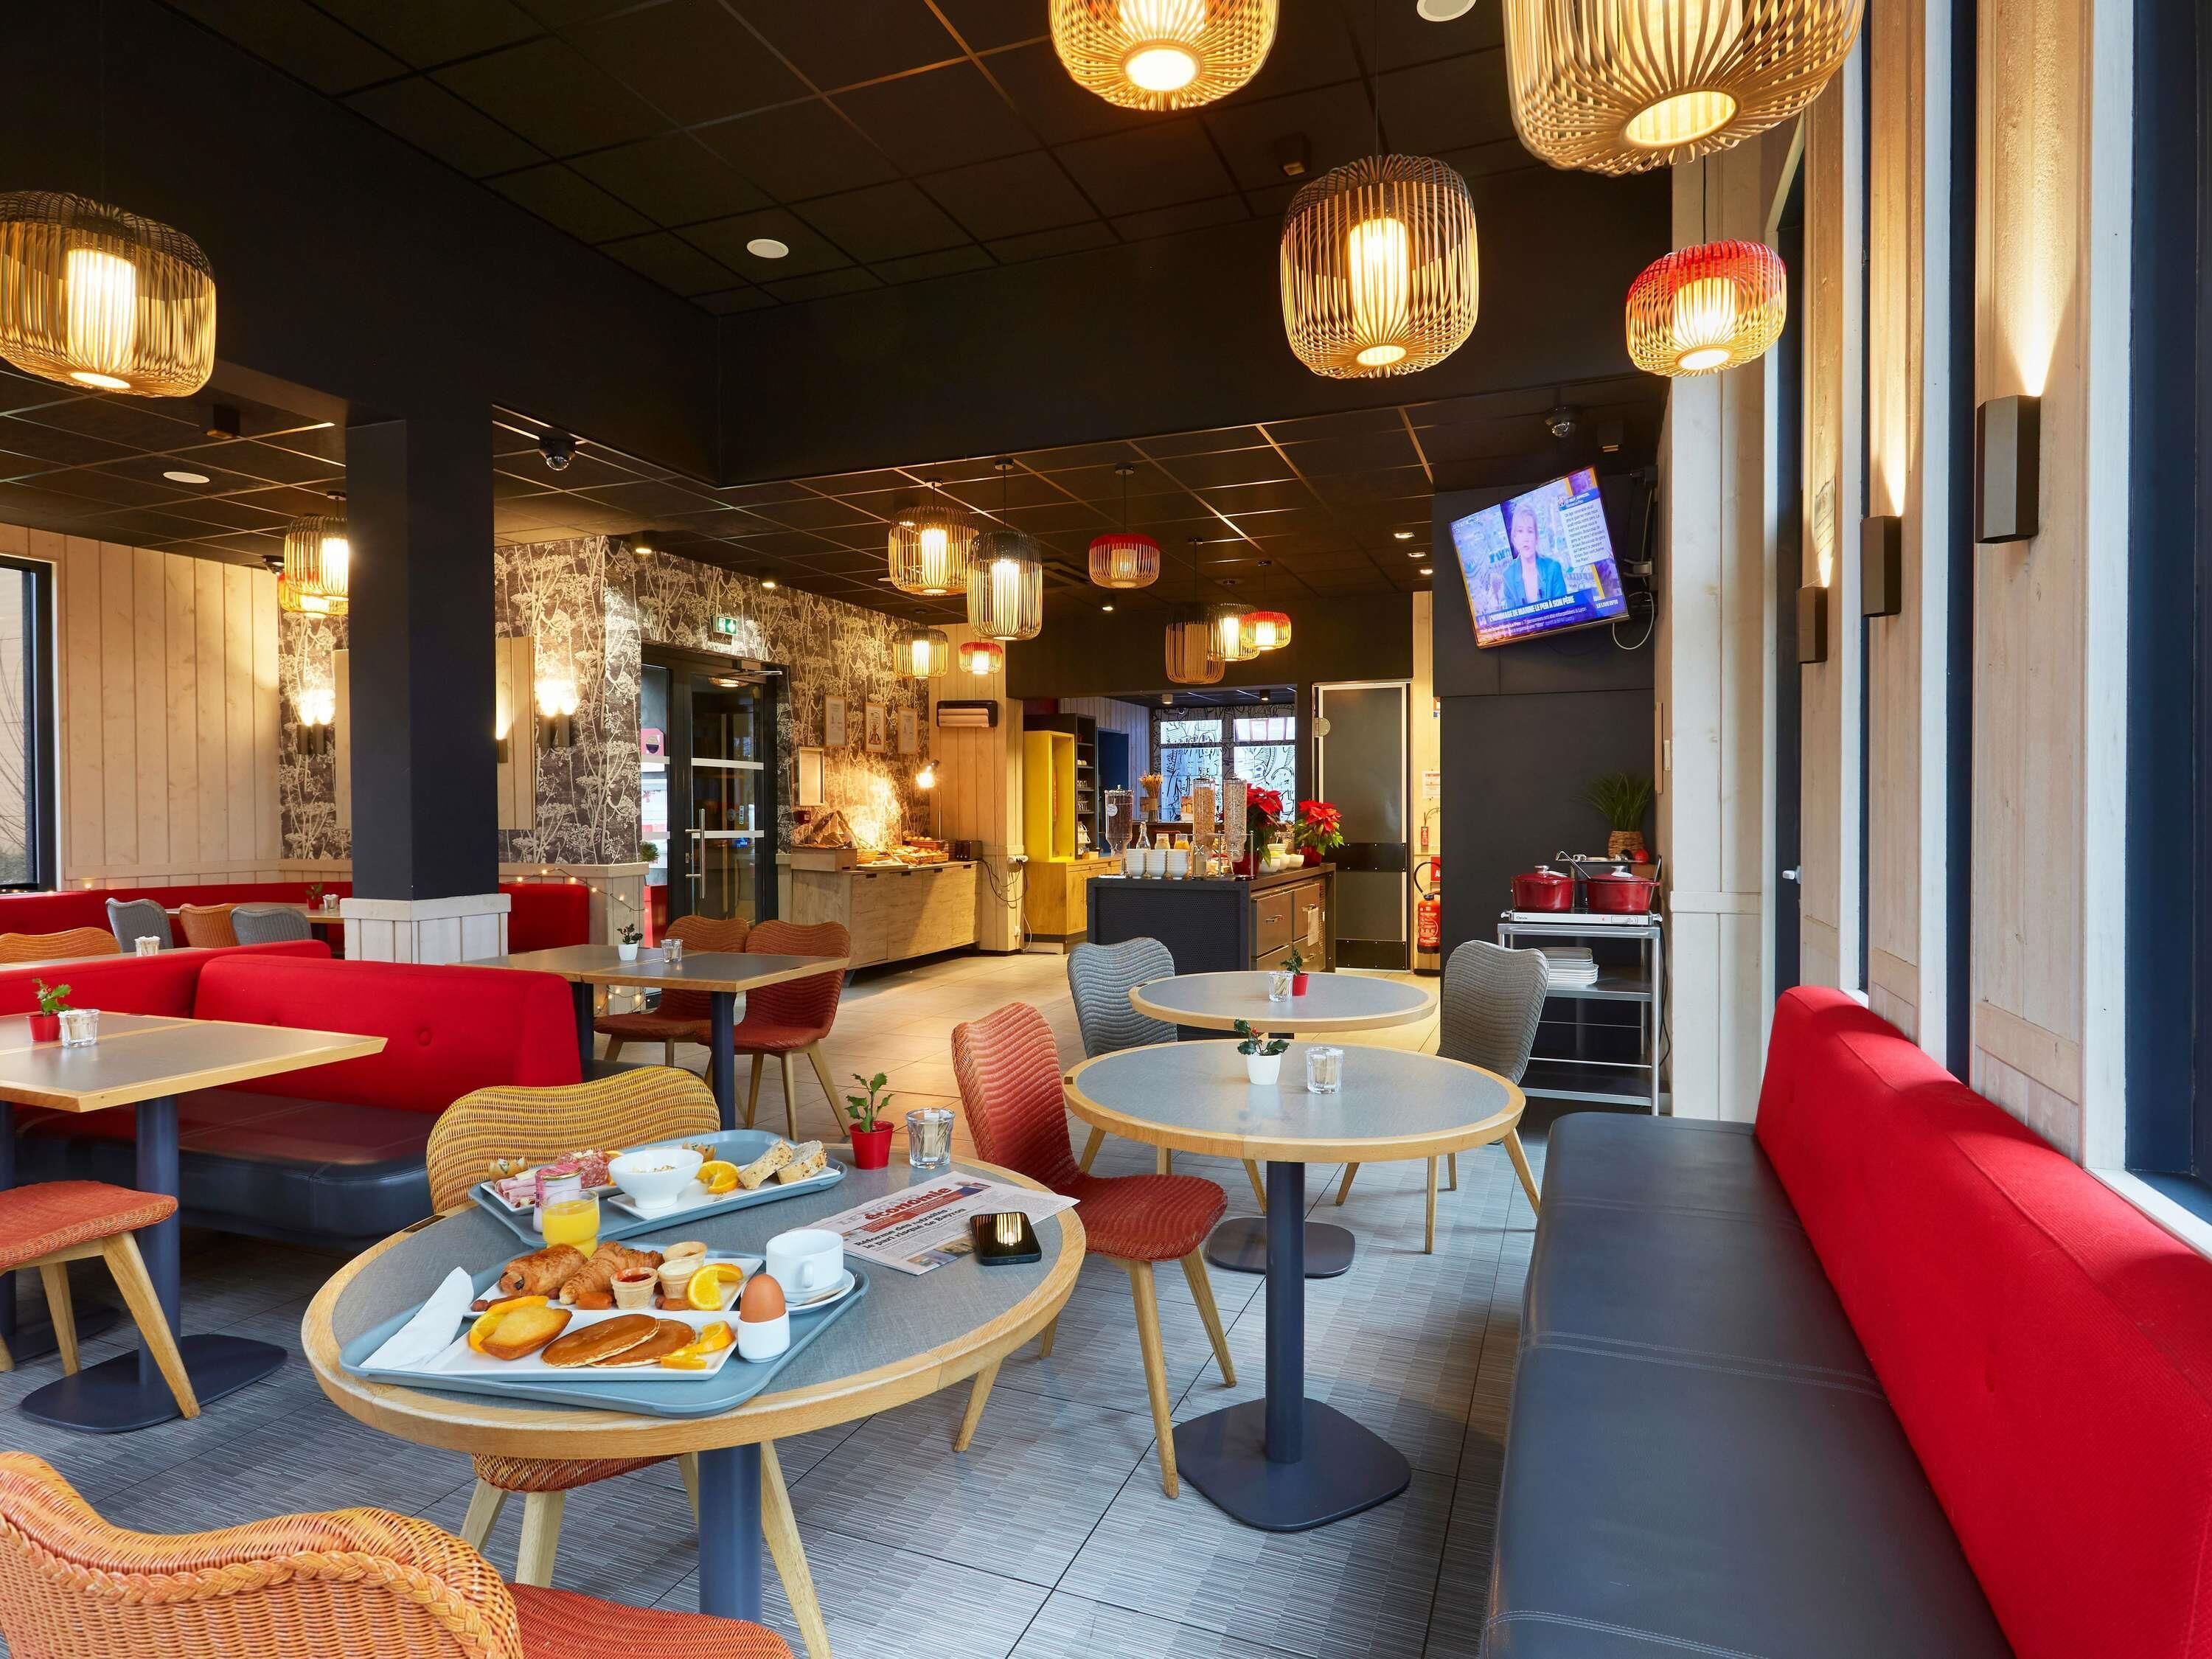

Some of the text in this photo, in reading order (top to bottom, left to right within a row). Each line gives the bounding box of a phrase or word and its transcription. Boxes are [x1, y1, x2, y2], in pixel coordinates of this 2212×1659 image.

[1535, 603, 1540, 611] LE
[1540, 601, 1549, 610] PEN
[1553, 598, 1563, 607] SON
[1563, 595, 1575, 605] PÈRE
[864, 1186, 953, 1221] économie
[854, 1230, 894, 1246] Réforme
[895, 1223, 911, 1232] des
[874, 1235, 895, 1246] pari
